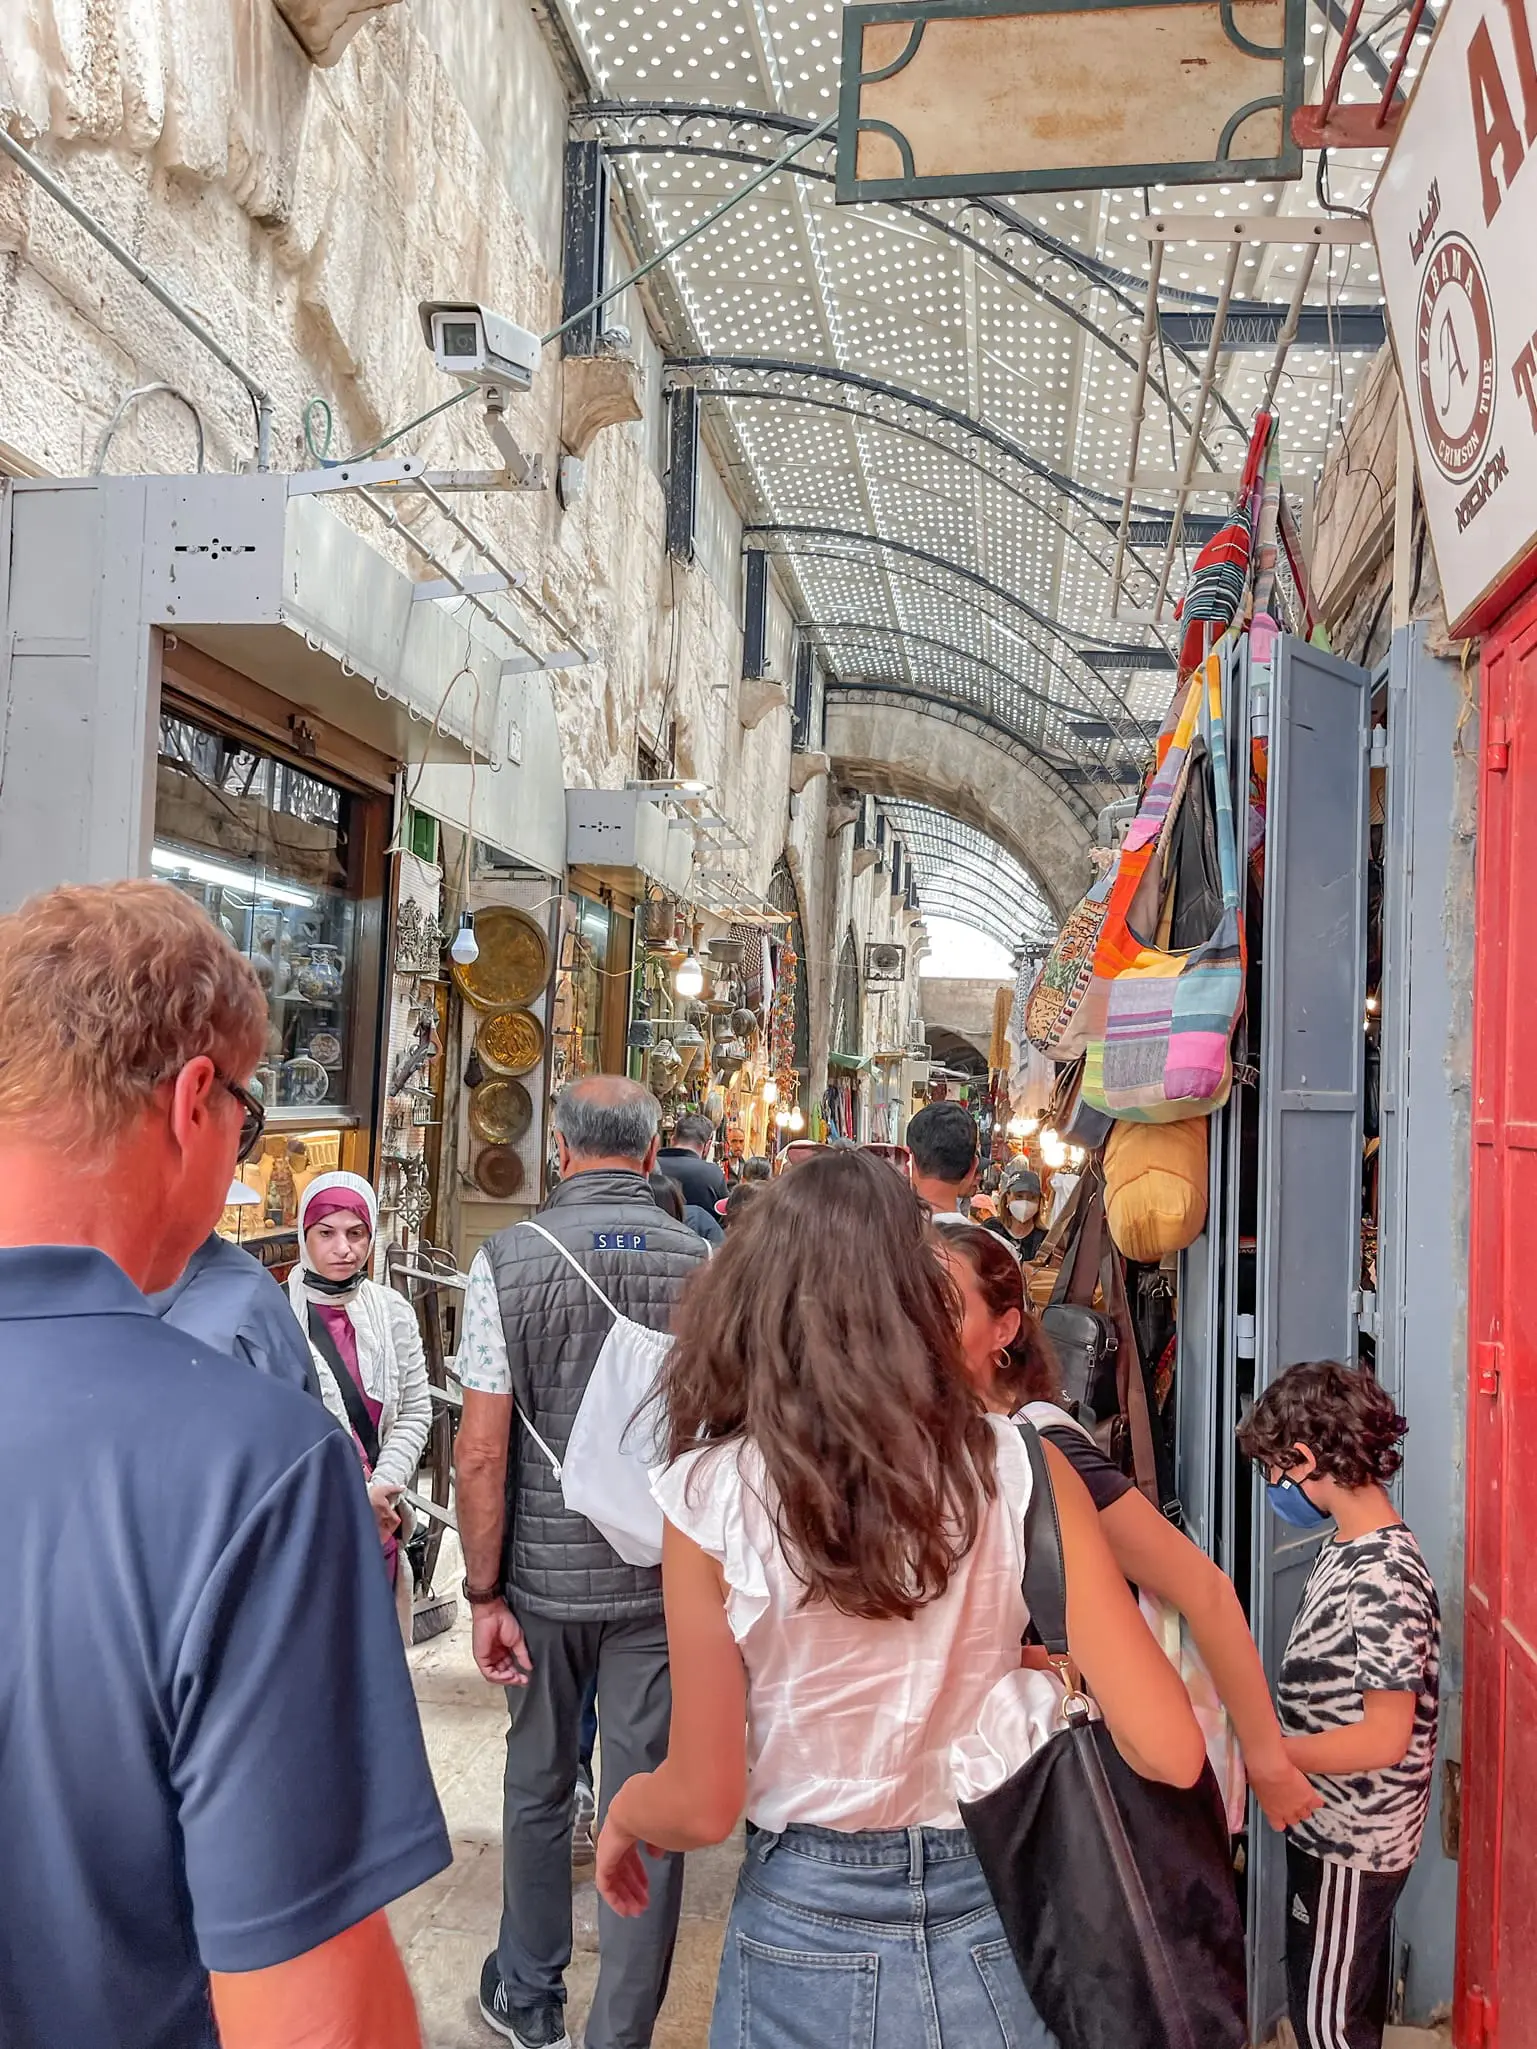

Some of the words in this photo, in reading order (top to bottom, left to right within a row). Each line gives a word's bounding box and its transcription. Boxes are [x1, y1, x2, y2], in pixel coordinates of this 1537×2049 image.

[1421, 249, 1473, 378] ALABAMA
[1438, 430, 1480, 467] CRIMSON
[1480, 358, 1492, 414] TIDE
[598, 1234, 641, 1249] SEP
